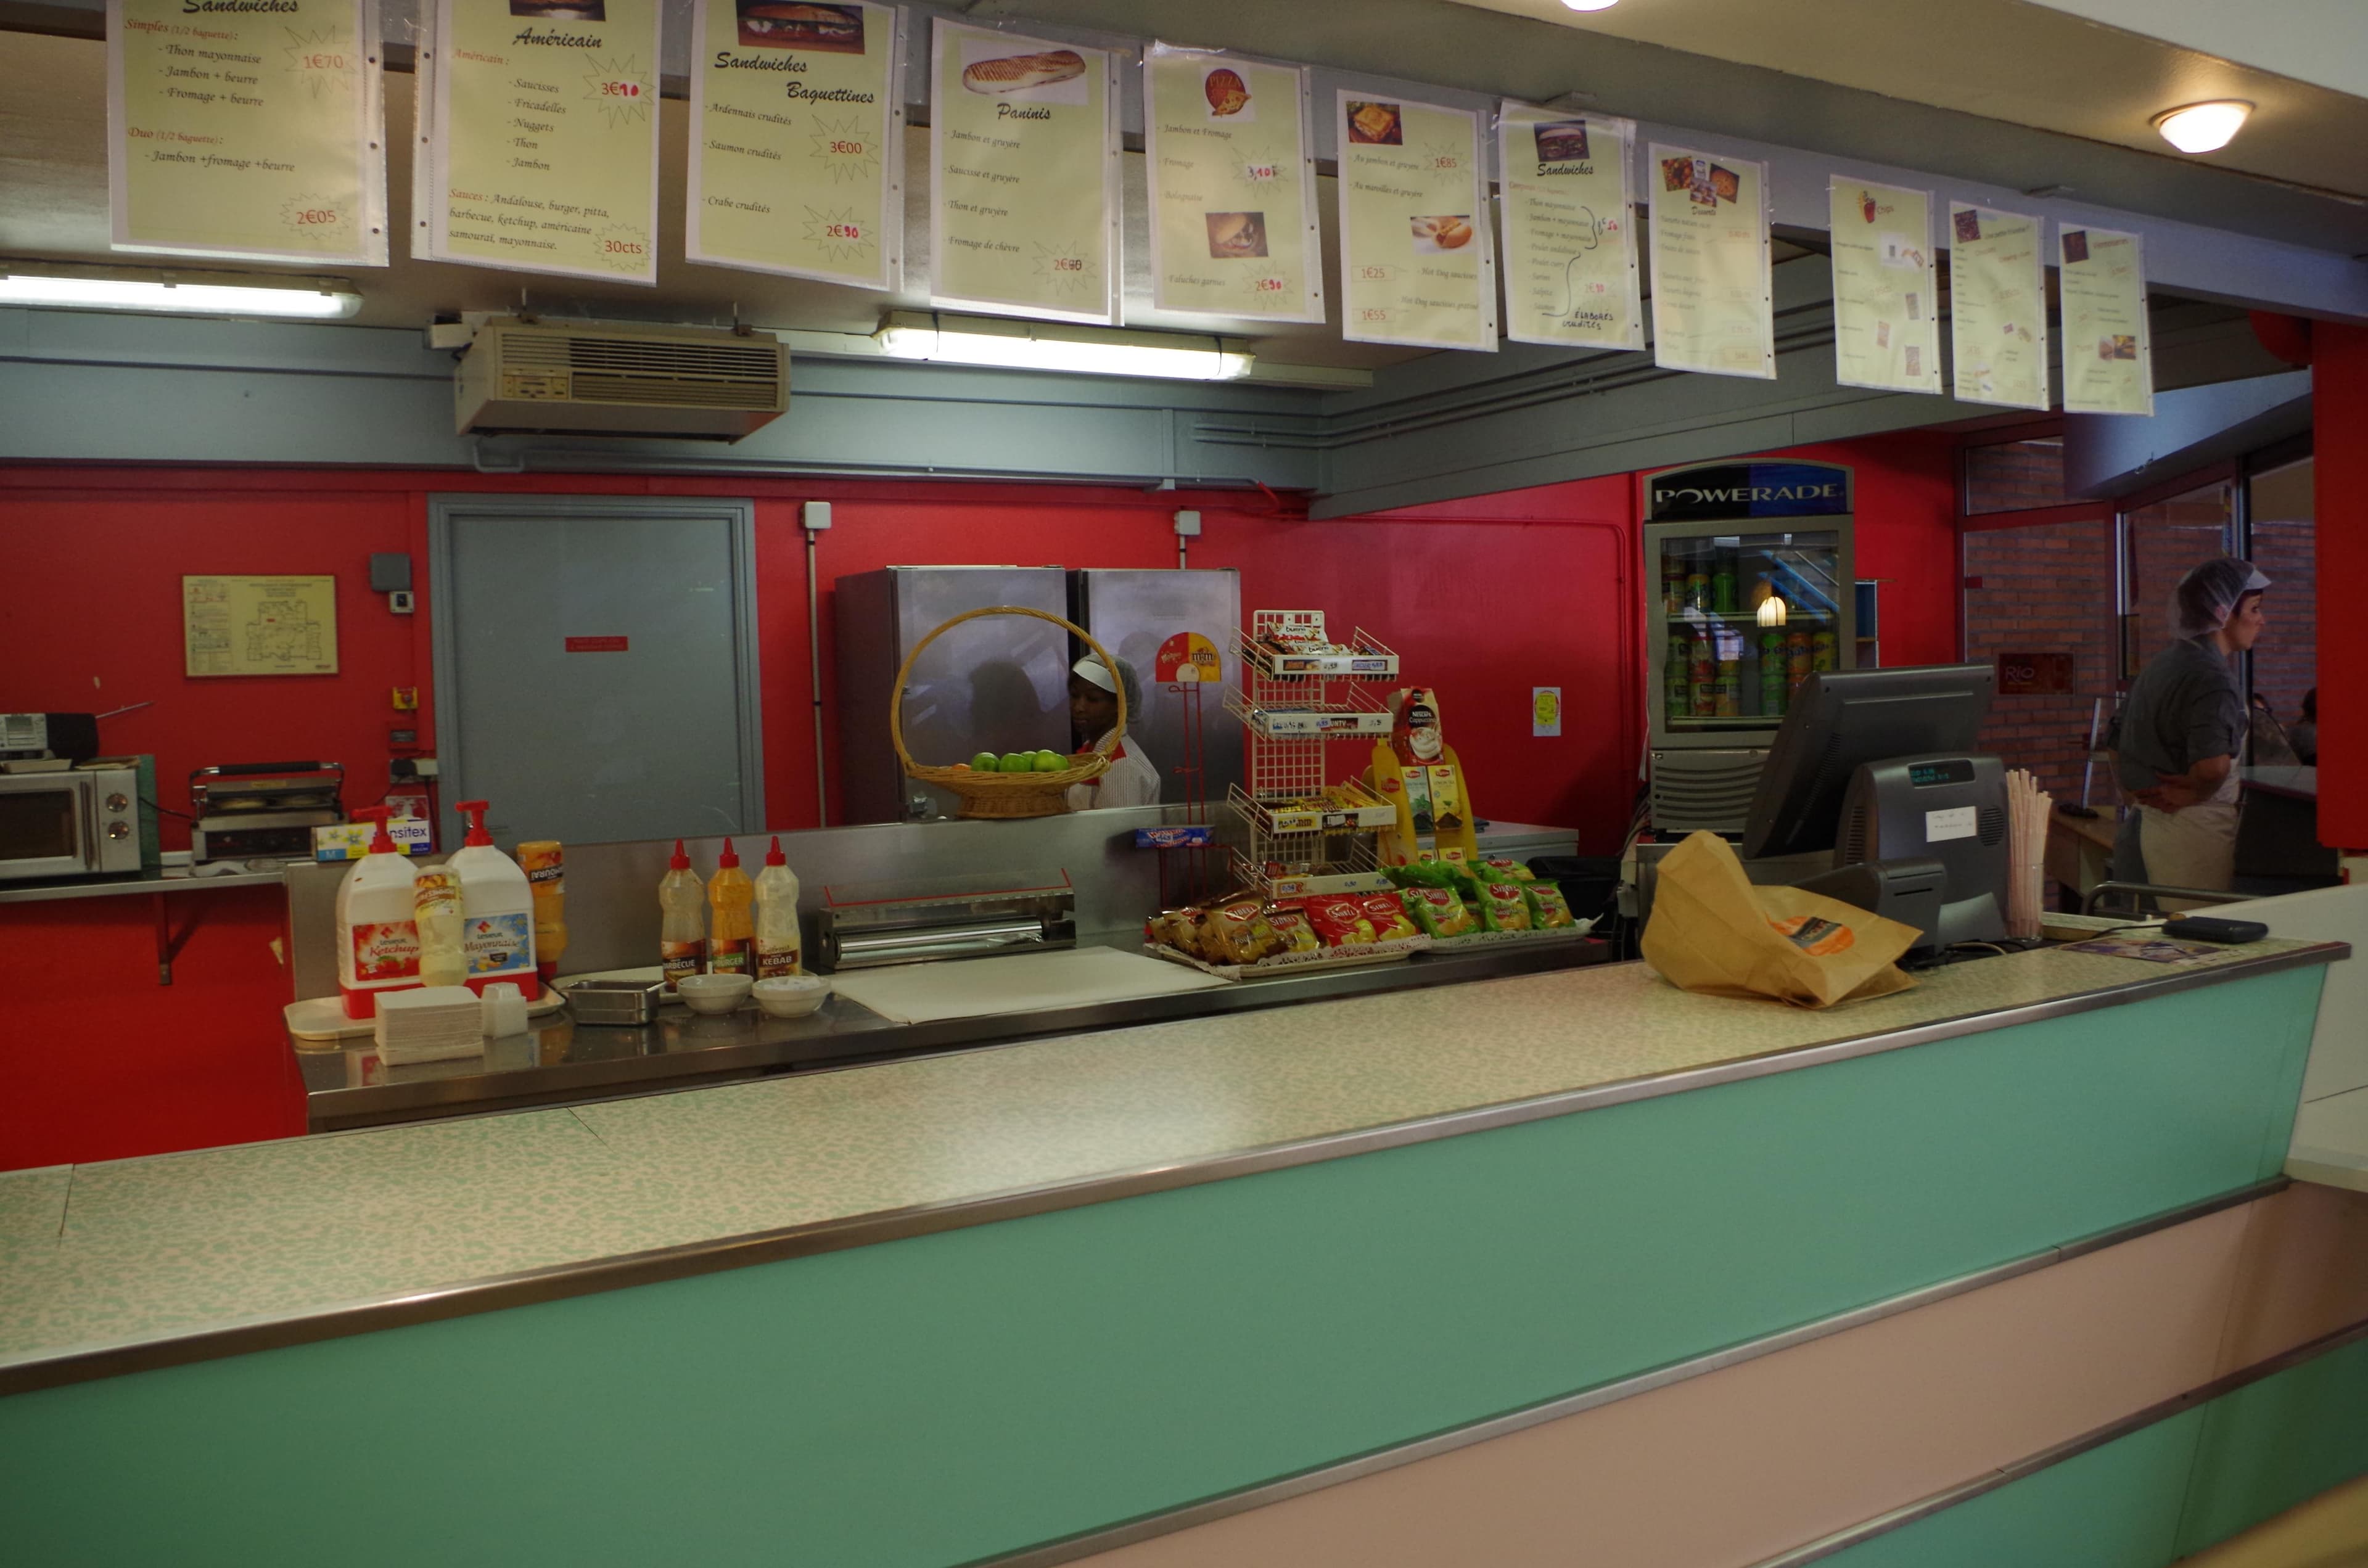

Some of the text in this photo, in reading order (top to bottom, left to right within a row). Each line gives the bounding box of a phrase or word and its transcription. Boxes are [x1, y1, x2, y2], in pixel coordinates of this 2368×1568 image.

[125, 19, 168, 33] Simples
[512, 27, 602, 49] Américain
[165, 44, 261, 65] Thon mayonnaise
[303, 55, 343, 69] 1€70
[452, 49, 504, 65] Américain
[714, 52, 807, 73] Sandwiches
[165, 66, 210, 80] Jambon
[224, 72, 258, 85] beurre
[514, 78, 559, 94] Saucisses
[786, 81, 875, 105] Baguettines
[166, 88, 216, 104] Fromage
[230, 93, 264, 107] beurre
[514, 98, 567, 115] Fricadelles
[709, 102, 792, 126] Ardennais crudités
[997, 102, 1051, 120] Paninis
[128, 127, 154, 139] Duo
[513, 118, 554, 133] Nuggets
[1164, 123, 1232, 139] Jambon et Fromage
[512, 138, 538, 150] Thon
[950, 129, 1020, 150] Jambon et gruyère
[709, 139, 781, 161] Saumon crudités
[830, 141, 862, 154] 3€00
[152, 151, 195, 164] Jambon
[512, 158, 551, 171] Jambon
[1163, 157, 1194, 169] Fromage
[1435, 158, 1457, 168] 1€85
[948, 165, 1020, 185] Saucisse et gruyère
[1537, 163, 1593, 176] Sandwiches
[450, 189, 609, 220] Sauces Andalouse, burger, pitta,
[707, 195, 770, 214] Crabe crudités
[948, 200, 1008, 218] Thon et gruyère
[297, 210, 336, 224] 2€05
[450, 208, 494, 223] barbecue,
[497, 215, 538, 231] ketchup,
[604, 240, 642, 254] 30cts
[948, 236, 982, 250] Fromage
[984, 240, 993, 250] de
[1361, 268, 1385, 279] 1€25
[1362, 310, 1386, 321] 1€55
[1655, 484, 1839, 503] POWERADE
[374, 827, 427, 839] nsitex
[369, 944, 419, 956] Ketchup
[464, 940, 519, 953] Mayonnaise
[763, 956, 792, 966] KEBAB
